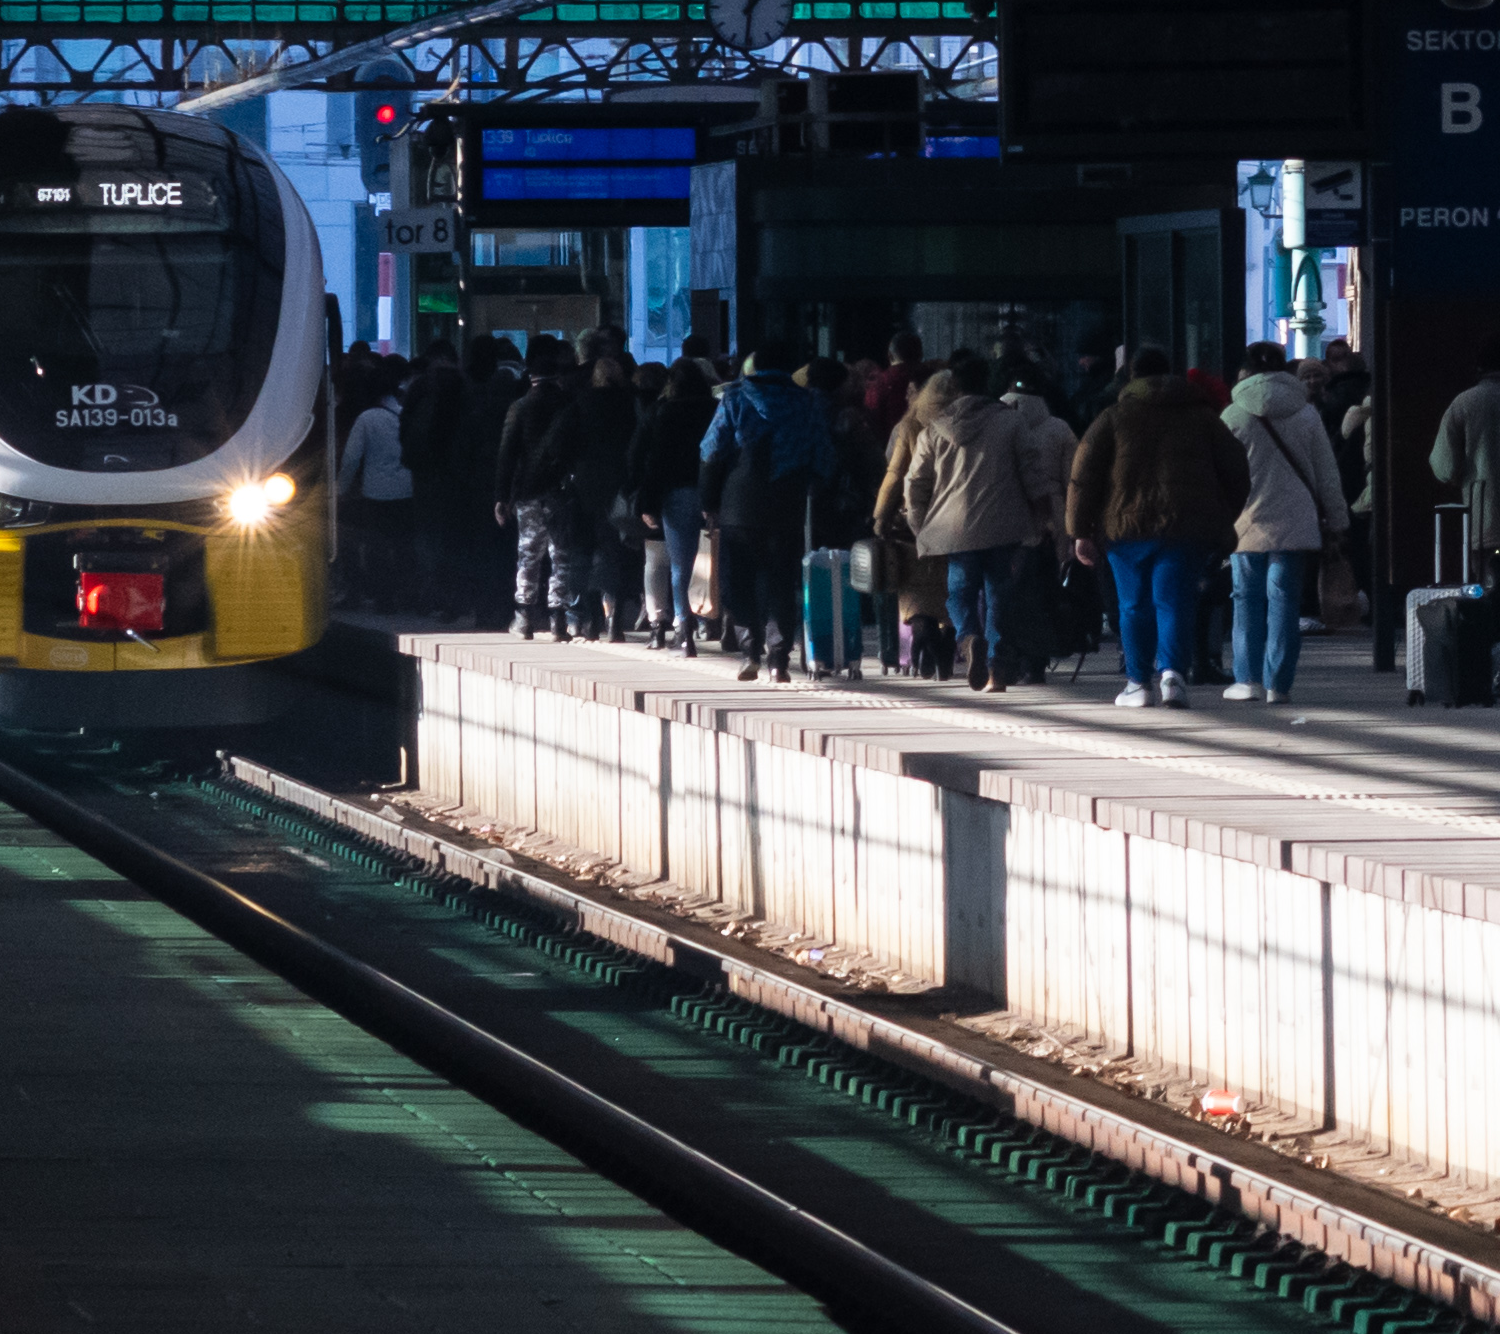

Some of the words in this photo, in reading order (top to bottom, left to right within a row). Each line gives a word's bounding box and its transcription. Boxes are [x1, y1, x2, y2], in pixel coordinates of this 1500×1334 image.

[1440, 82, 1484, 135] B
[99, 182, 183, 205] TUPLICE
[1400, 207, 1489, 228] PERON
[385, 218, 424, 244] tor
[433, 218, 449, 243] 8
[71, 384, 118, 406] KD
[56, 408, 178, 427] SA139-013a
